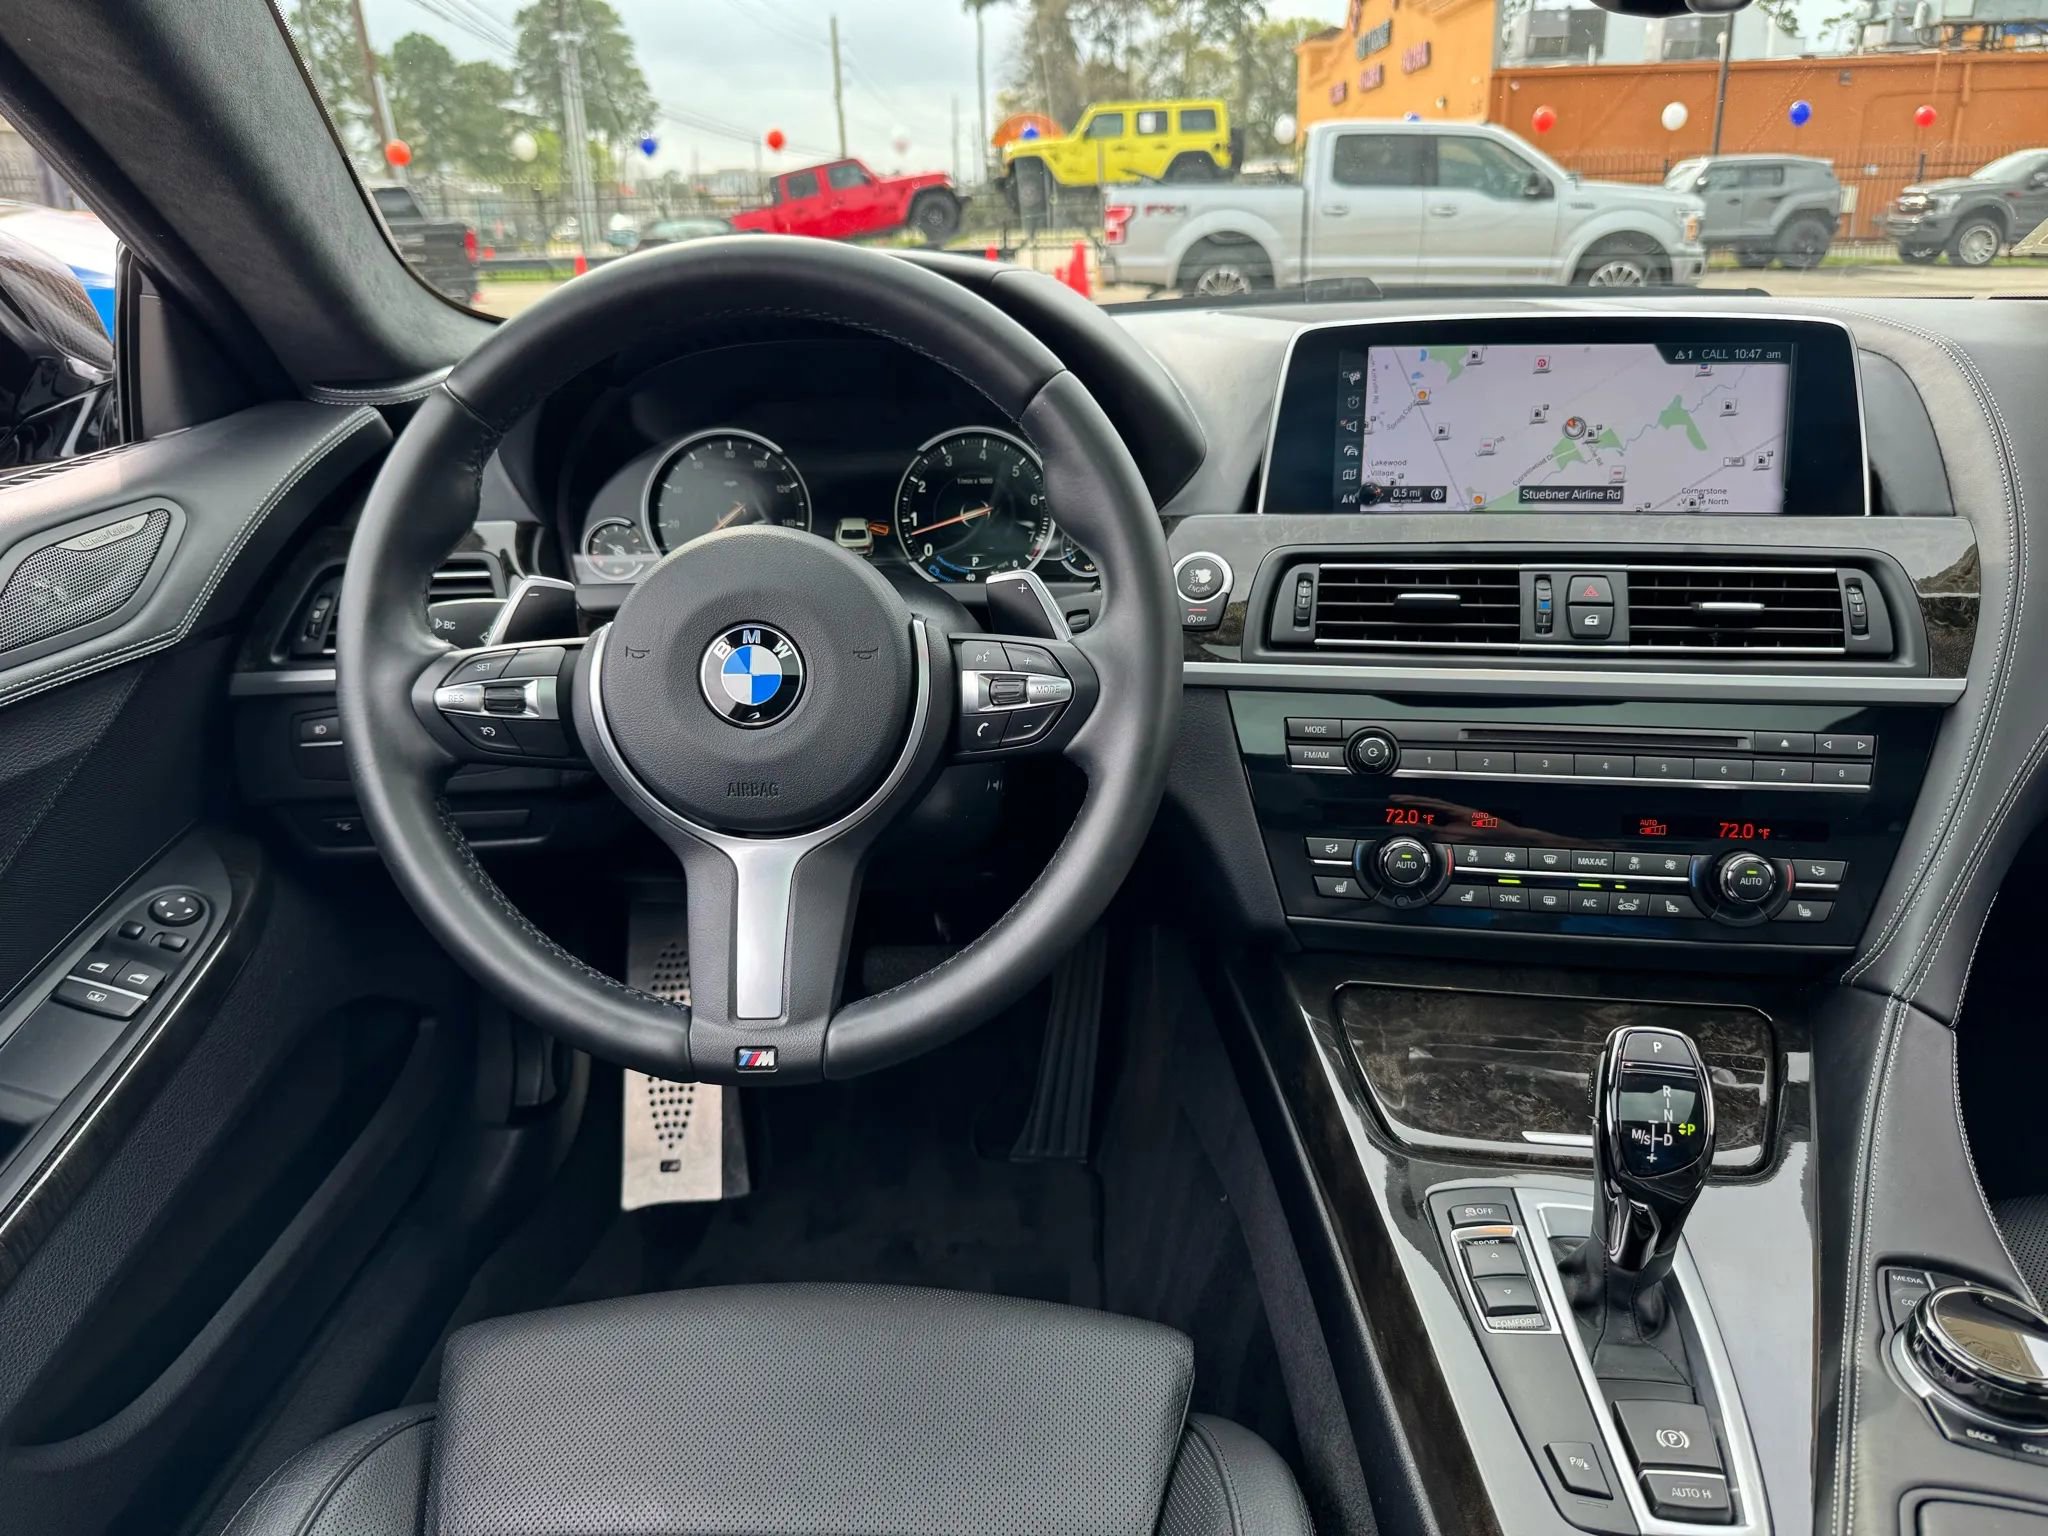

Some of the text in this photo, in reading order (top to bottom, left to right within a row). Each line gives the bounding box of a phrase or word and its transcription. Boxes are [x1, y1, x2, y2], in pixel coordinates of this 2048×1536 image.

[1701, 350, 1729, 359] CALL
[1734, 349, 1762, 359] 10:47
[1766, 351, 1781, 359] am
[979, 449, 987, 461] 4
[945, 455, 953, 467] 3
[1011, 466, 1020, 477] 5
[918, 481, 927, 493] 2
[1681, 487, 1727, 495] Cornerstone
[1393, 488, 1420, 498] 0.5 mi
[1522, 489, 1621, 500] Stuebner Airline Rd
[1030, 494, 1038, 505] 6
[910, 511, 918, 527] 1
[1028, 530, 1036, 542] 7
[924, 543, 934, 557] 0
[971, 556, 980, 567] P
[443, 620, 456, 630] BC
[712, 629, 794, 661] BMW
[476, 662, 491, 672] SET
[1036, 685, 1061, 694] MODE
[448, 694, 465, 704] RES
[1304, 725, 1327, 734] MODE
[1303, 750, 1330, 760] FM/AM
[1483, 758, 1489, 766] 2
[1542, 760, 1548, 768] 3
[1602, 762, 1608, 770] 4
[1661, 764, 1667, 772] 5
[1720, 766, 1727, 774] 6
[1780, 768, 1786, 776] 7
[1838, 769, 1845, 777] 8
[726, 782, 779, 798] AIRBAG
[1385, 808, 1419, 825] 72.0
[1719, 822, 1755, 839] 72.0
[1395, 861, 1418, 870] AUTO
[1739, 877, 1763, 886] AUTO
[1499, 894, 1521, 903] SYNC
[1582, 899, 1597, 907] A/C
[1652, 1041, 1662, 1053] P
[1662, 1085, 1672, 1098] R
[1663, 1109, 1673, 1122] N
[1687, 1123, 1696, 1136] P
[1663, 1133, 1673, 1146] D
[1476, 1207, 1494, 1216] OFF
[1892, 1274, 1924, 1285] MEDIA
[1495, 1317, 1537, 1328] COMFORT
[1966, 1428, 1998, 1444] BACK
[1671, 1487, 1712, 1500] AUTO H
